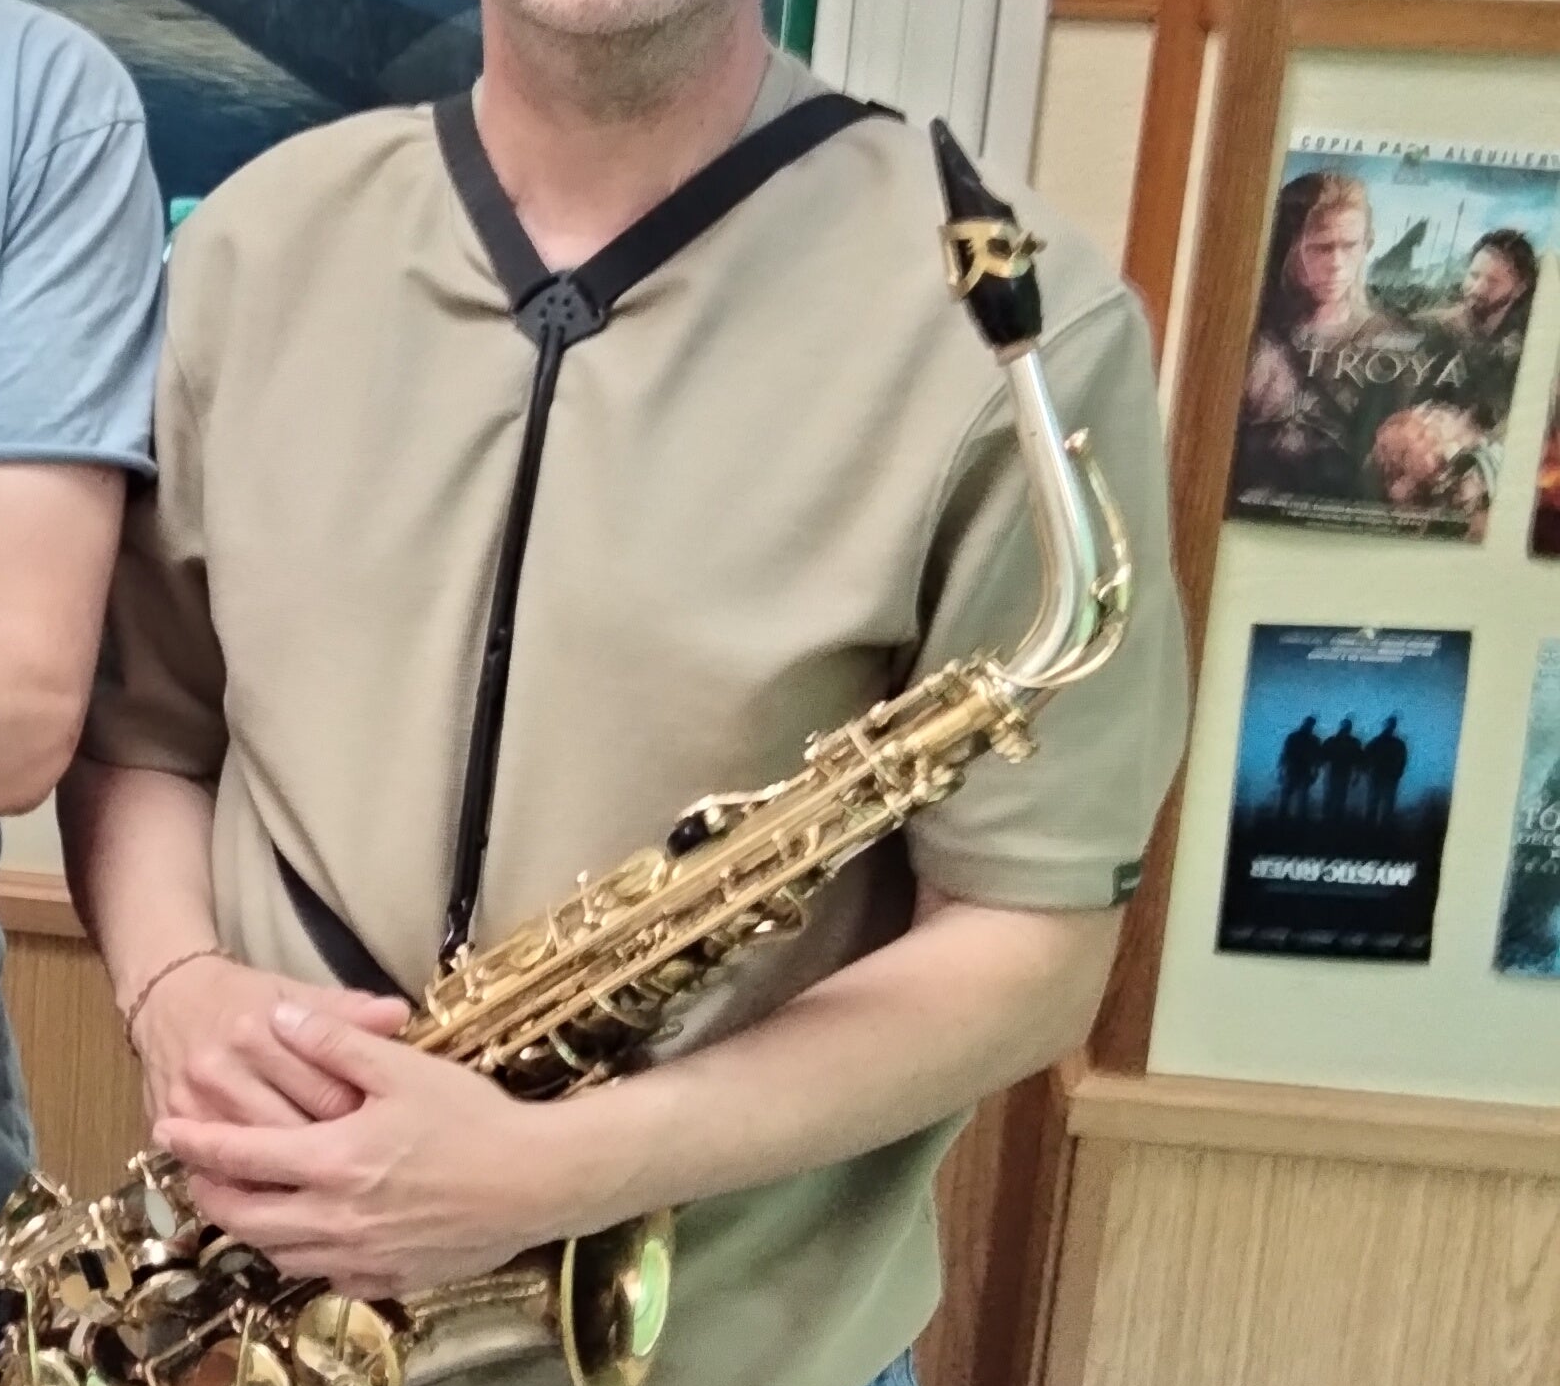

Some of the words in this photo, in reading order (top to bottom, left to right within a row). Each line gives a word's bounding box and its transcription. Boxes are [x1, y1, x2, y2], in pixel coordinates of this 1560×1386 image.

[1301, 135, 1364, 152] COPIA
[1378, 142, 1430, 158] PAA
[1294, 347, 1468, 389] TROYA
